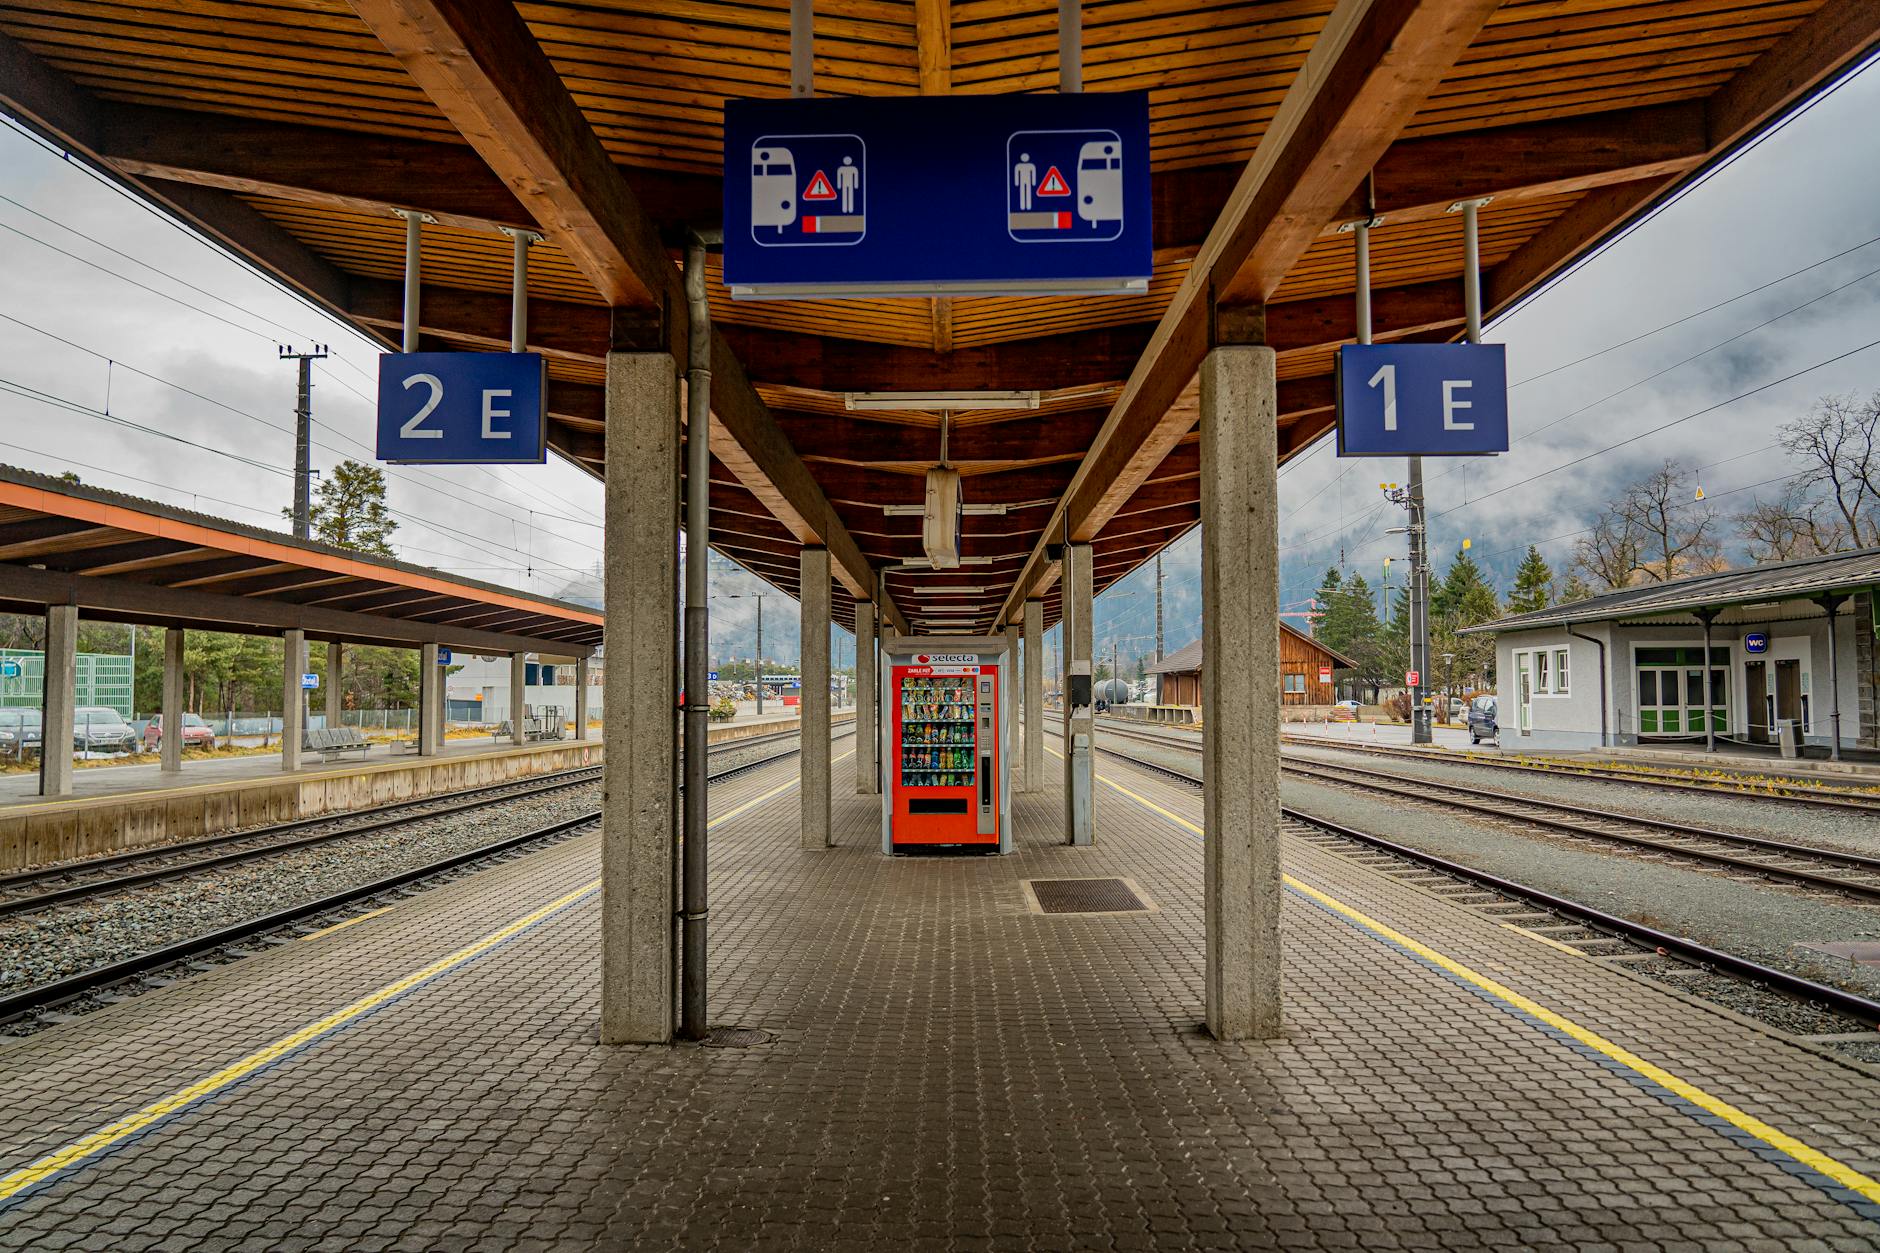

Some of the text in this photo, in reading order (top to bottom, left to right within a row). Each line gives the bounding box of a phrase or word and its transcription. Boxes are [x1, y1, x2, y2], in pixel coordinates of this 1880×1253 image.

[399, 373, 512, 439] 2 E
[1367, 364, 1475, 431] 1 E
[932, 654, 974, 662] selecta
[1748, 639, 1764, 647] WC
